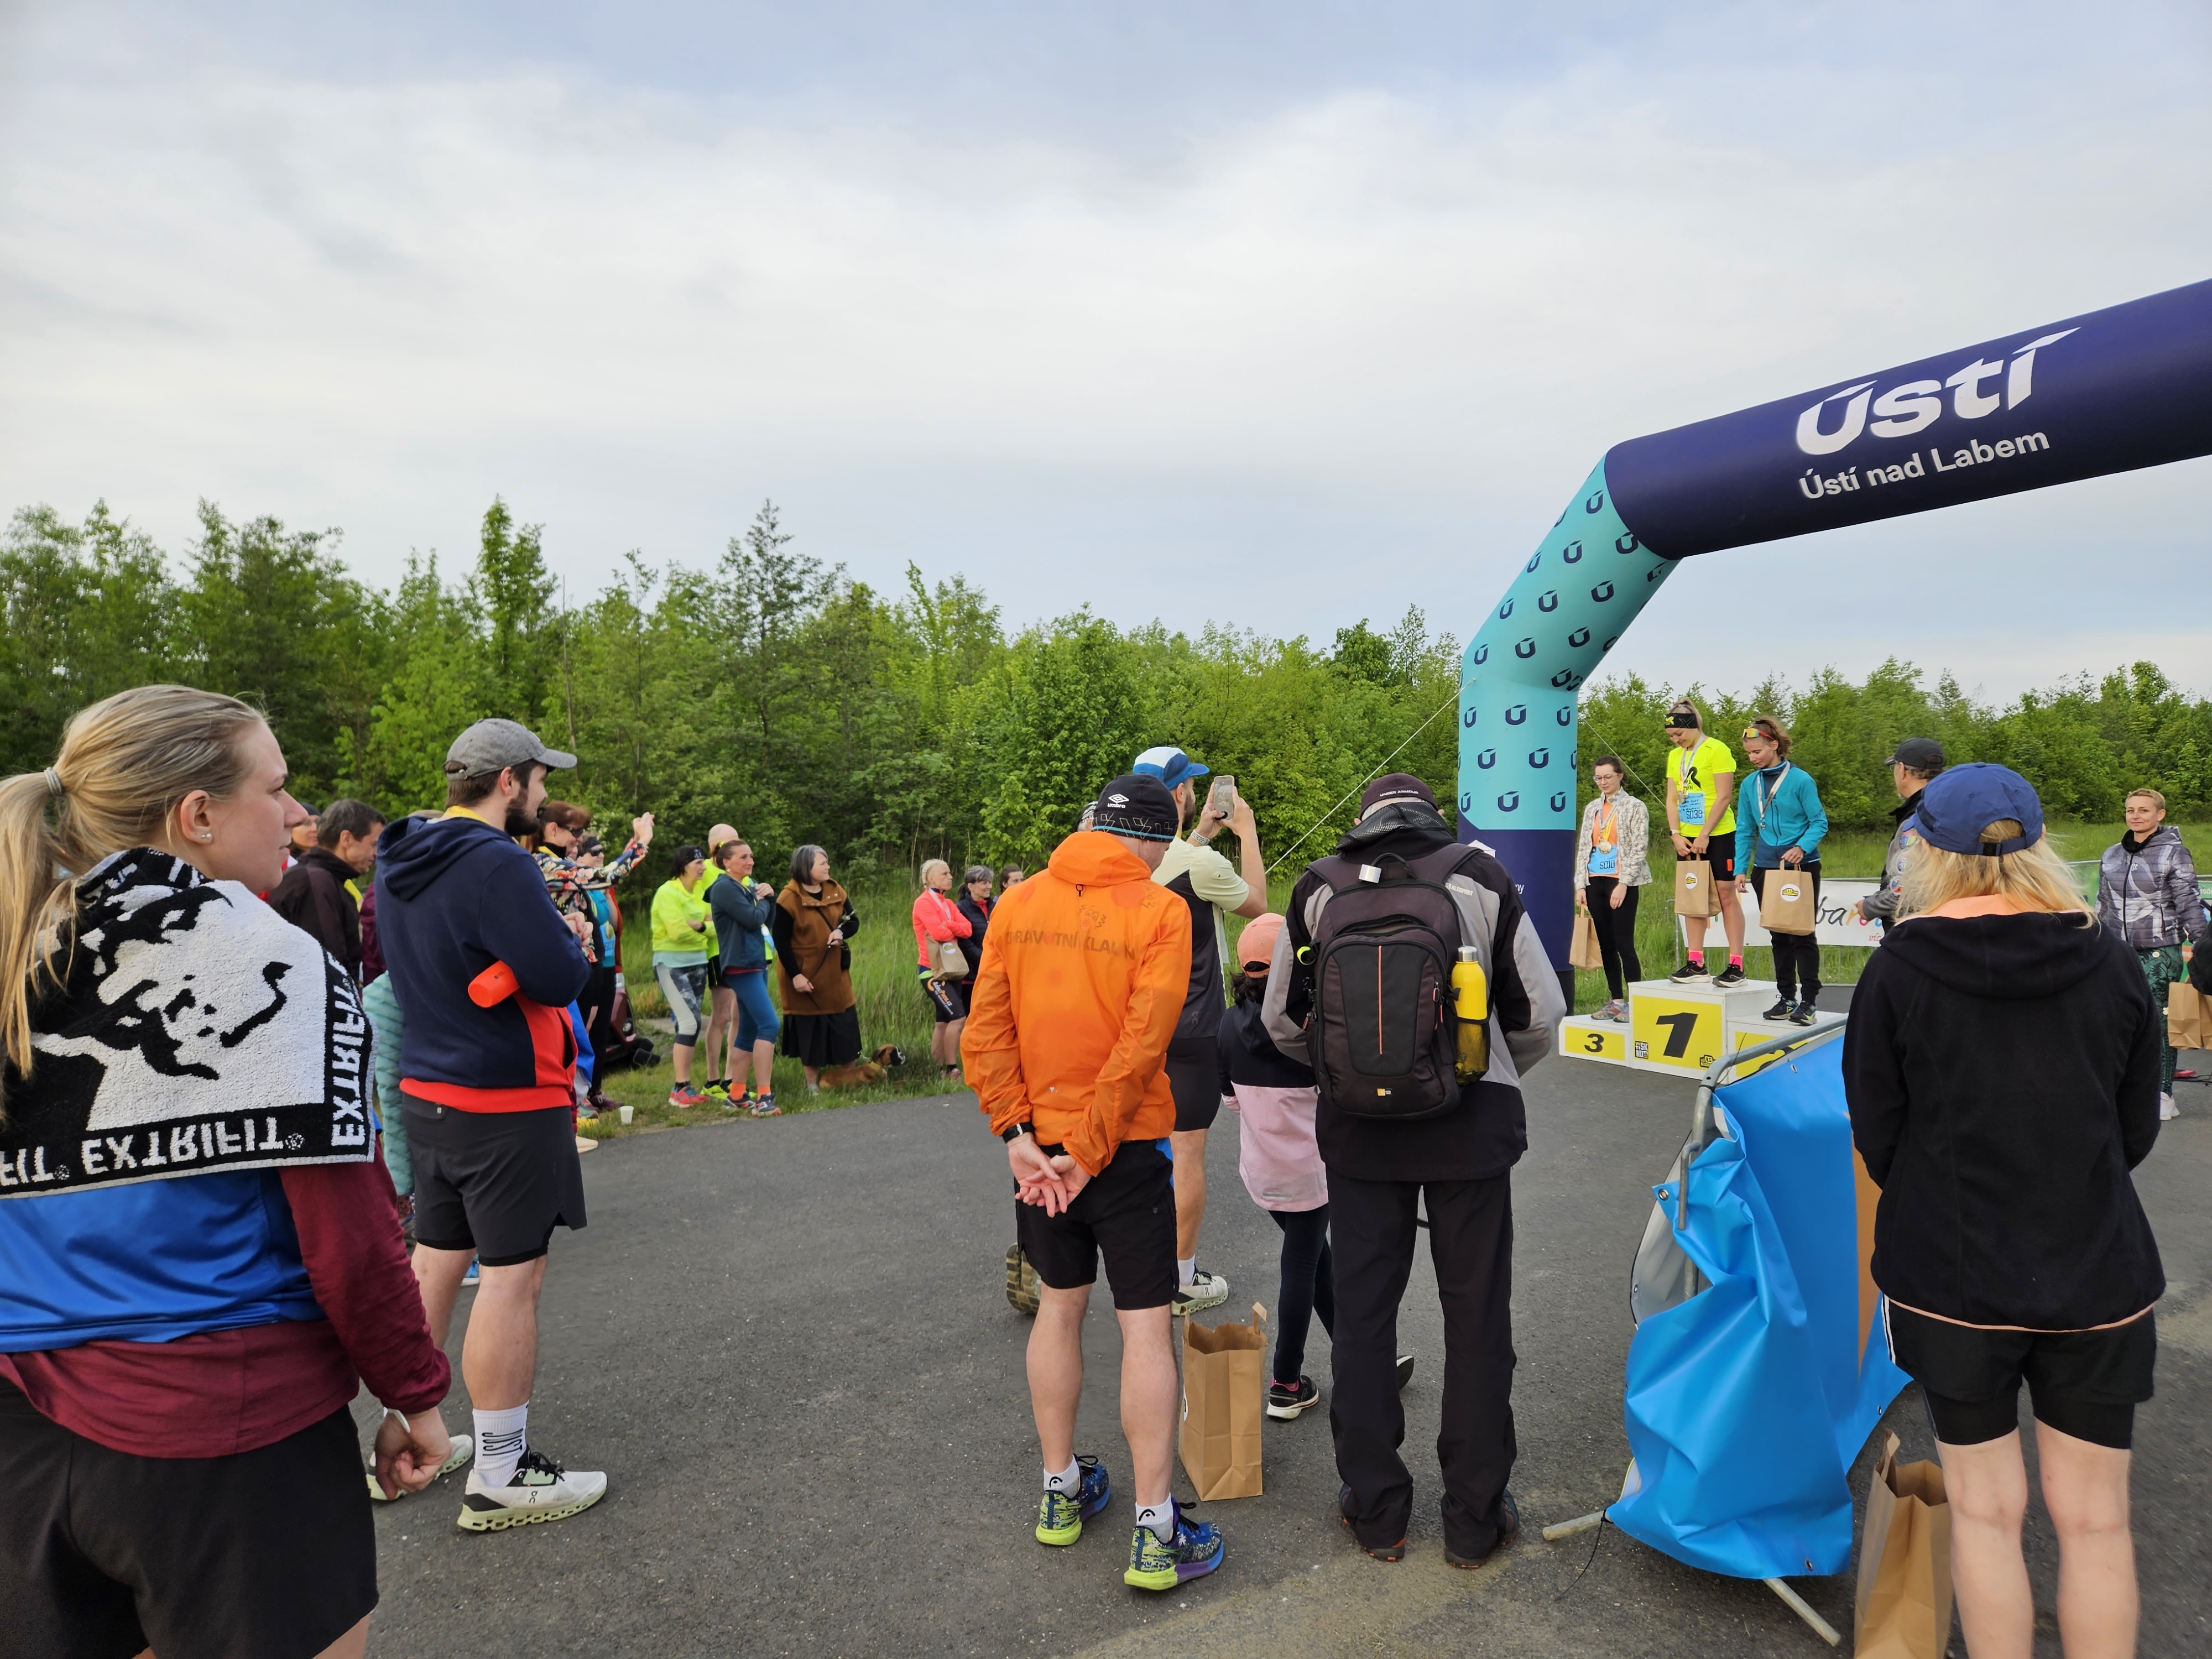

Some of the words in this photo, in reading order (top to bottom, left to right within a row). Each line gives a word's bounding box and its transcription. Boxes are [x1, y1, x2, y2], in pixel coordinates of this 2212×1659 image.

[1796, 327, 2081, 455] Ústí
[1799, 468, 1860, 498] Ústí
[1867, 452, 1926, 487] nad
[1931, 431, 2050, 472] Labem
[1584, 1034, 1604, 1052] 3
[1656, 1012, 1698, 1058] 1
